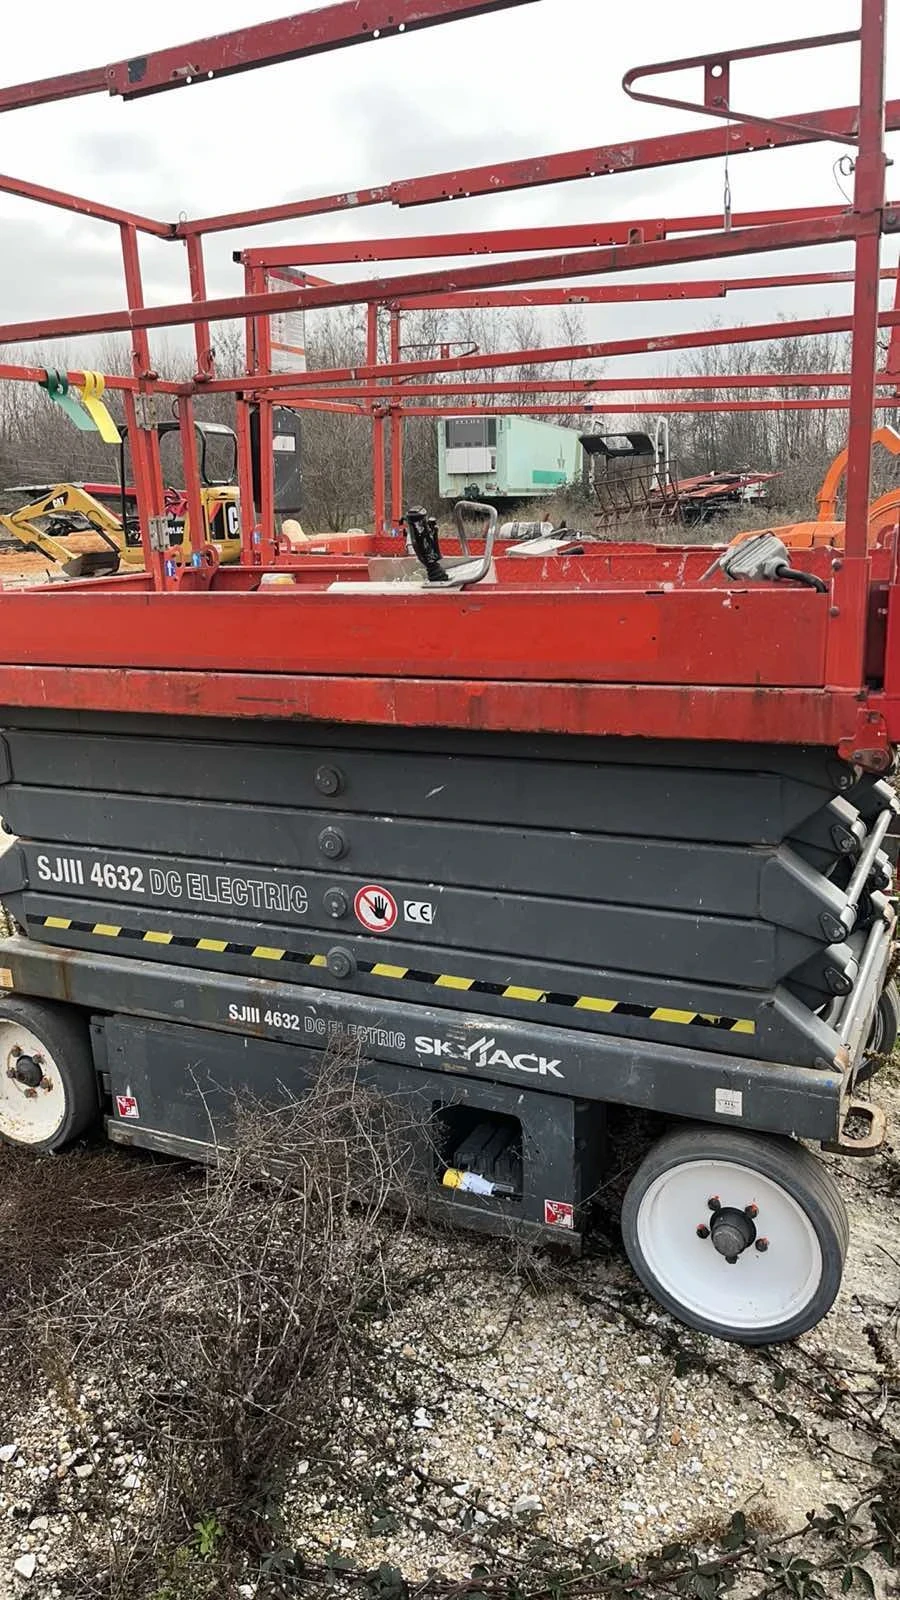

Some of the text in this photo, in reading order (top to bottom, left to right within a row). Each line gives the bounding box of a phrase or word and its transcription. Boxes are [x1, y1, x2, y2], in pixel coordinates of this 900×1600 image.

[37, 855, 308, 914] SJIII 4632 DC ELECTRIC
[406, 902, 431, 922] CE
[228, 1003, 260, 1024] SJIII
[264, 1010, 301, 1031] 4632
[304, 1016, 326, 1035] DC
[414, 1036, 565, 1079] SKYJACK
